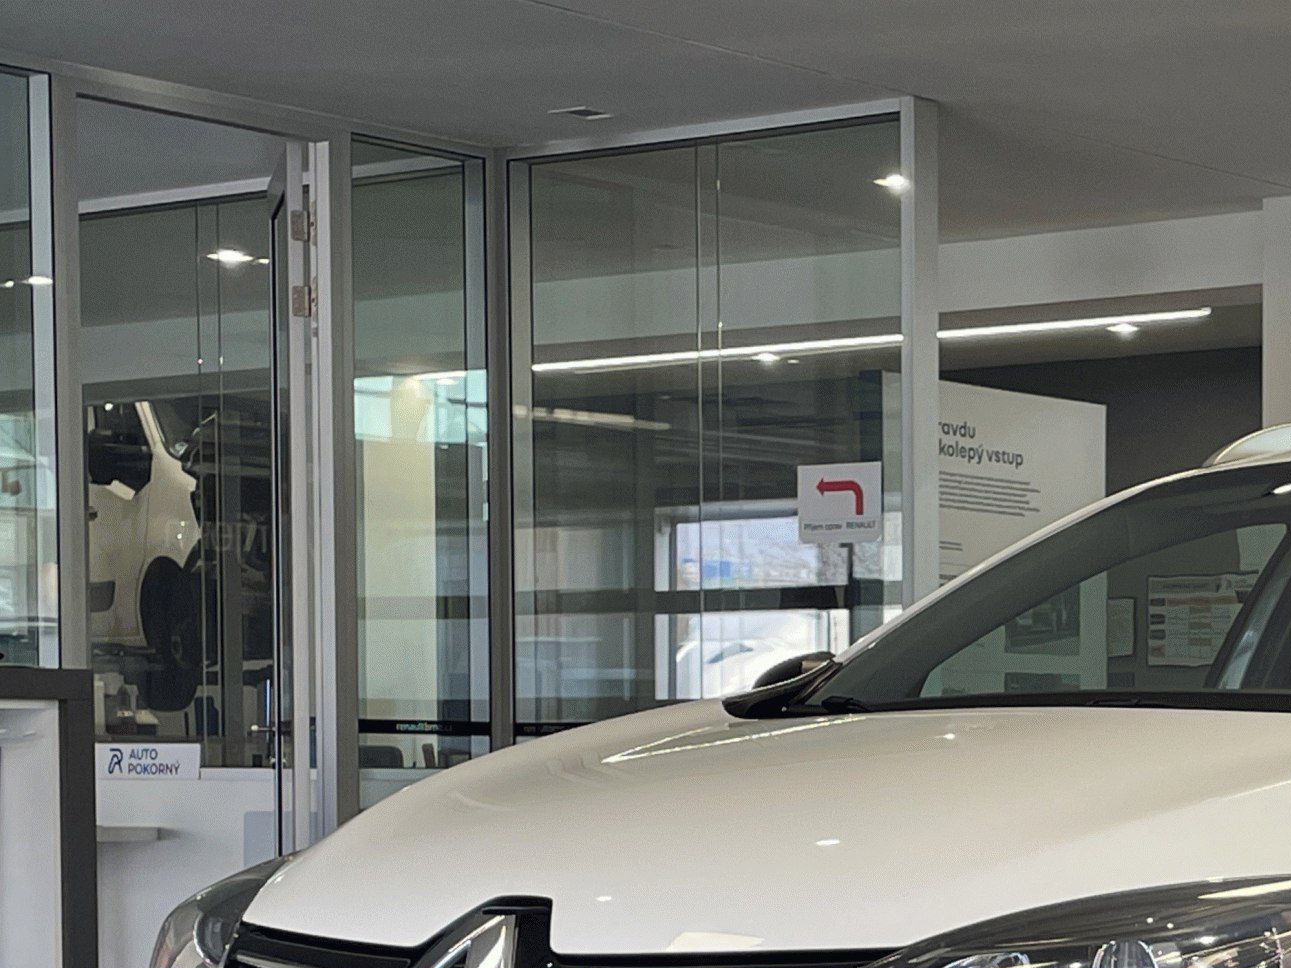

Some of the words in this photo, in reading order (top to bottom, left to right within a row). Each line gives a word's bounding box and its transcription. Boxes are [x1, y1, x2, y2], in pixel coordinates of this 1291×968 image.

[938, 438, 984, 465] kolepý
[986, 450, 1024, 470] vstup
[846, 519, 876, 529] RENAULT
[129, 748, 158, 760] AUTO
[127, 760, 181, 775] POKORNÝ
